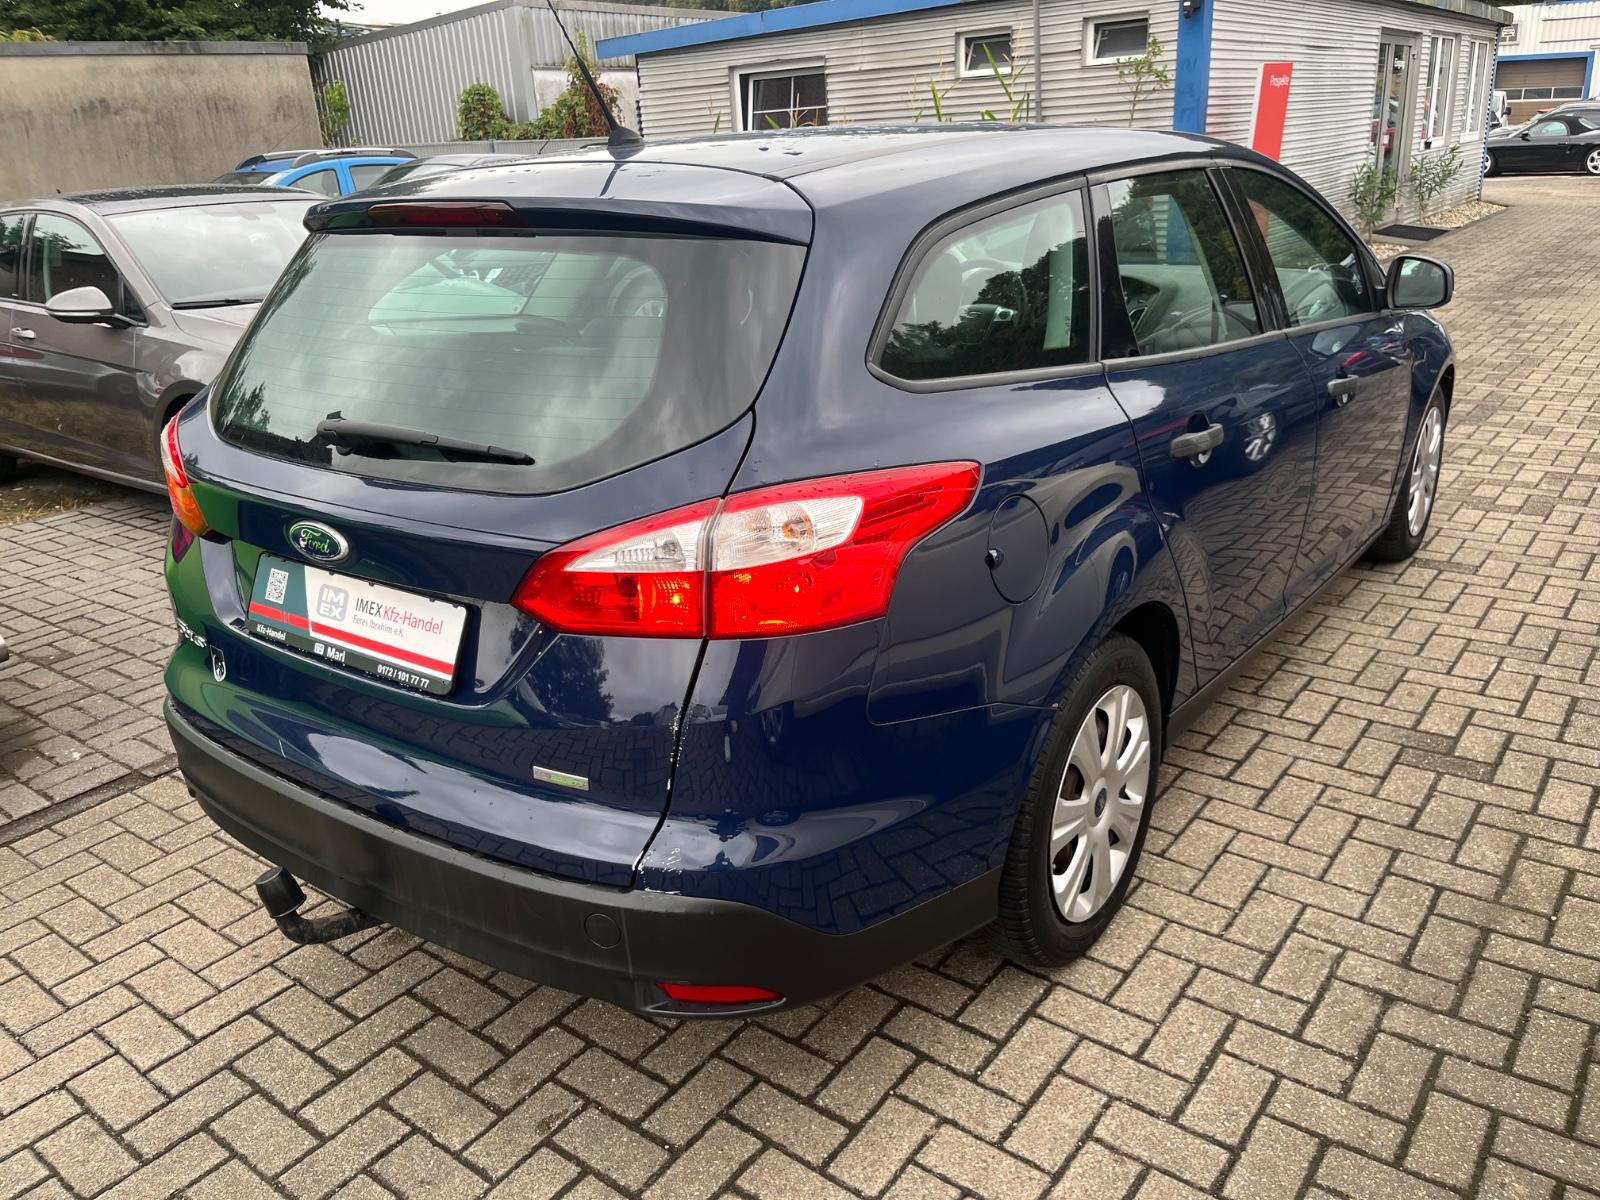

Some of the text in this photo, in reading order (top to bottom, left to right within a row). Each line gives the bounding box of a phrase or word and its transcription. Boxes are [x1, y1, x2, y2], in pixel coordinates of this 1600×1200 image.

[300, 528, 331, 554] Ford
[321, 587, 345, 607] IM
[319, 602, 344, 620] EX
[355, 597, 444, 636] IMEX Kfz-Handel
[256, 623, 287, 641] Kfz-Handel
[326, 646, 346, 663] Marl
[377, 664, 393, 677] 0172
[397, 670, 410, 682] 101
[410, 674, 420, 685] 77
[420, 678, 430, 689] 77
